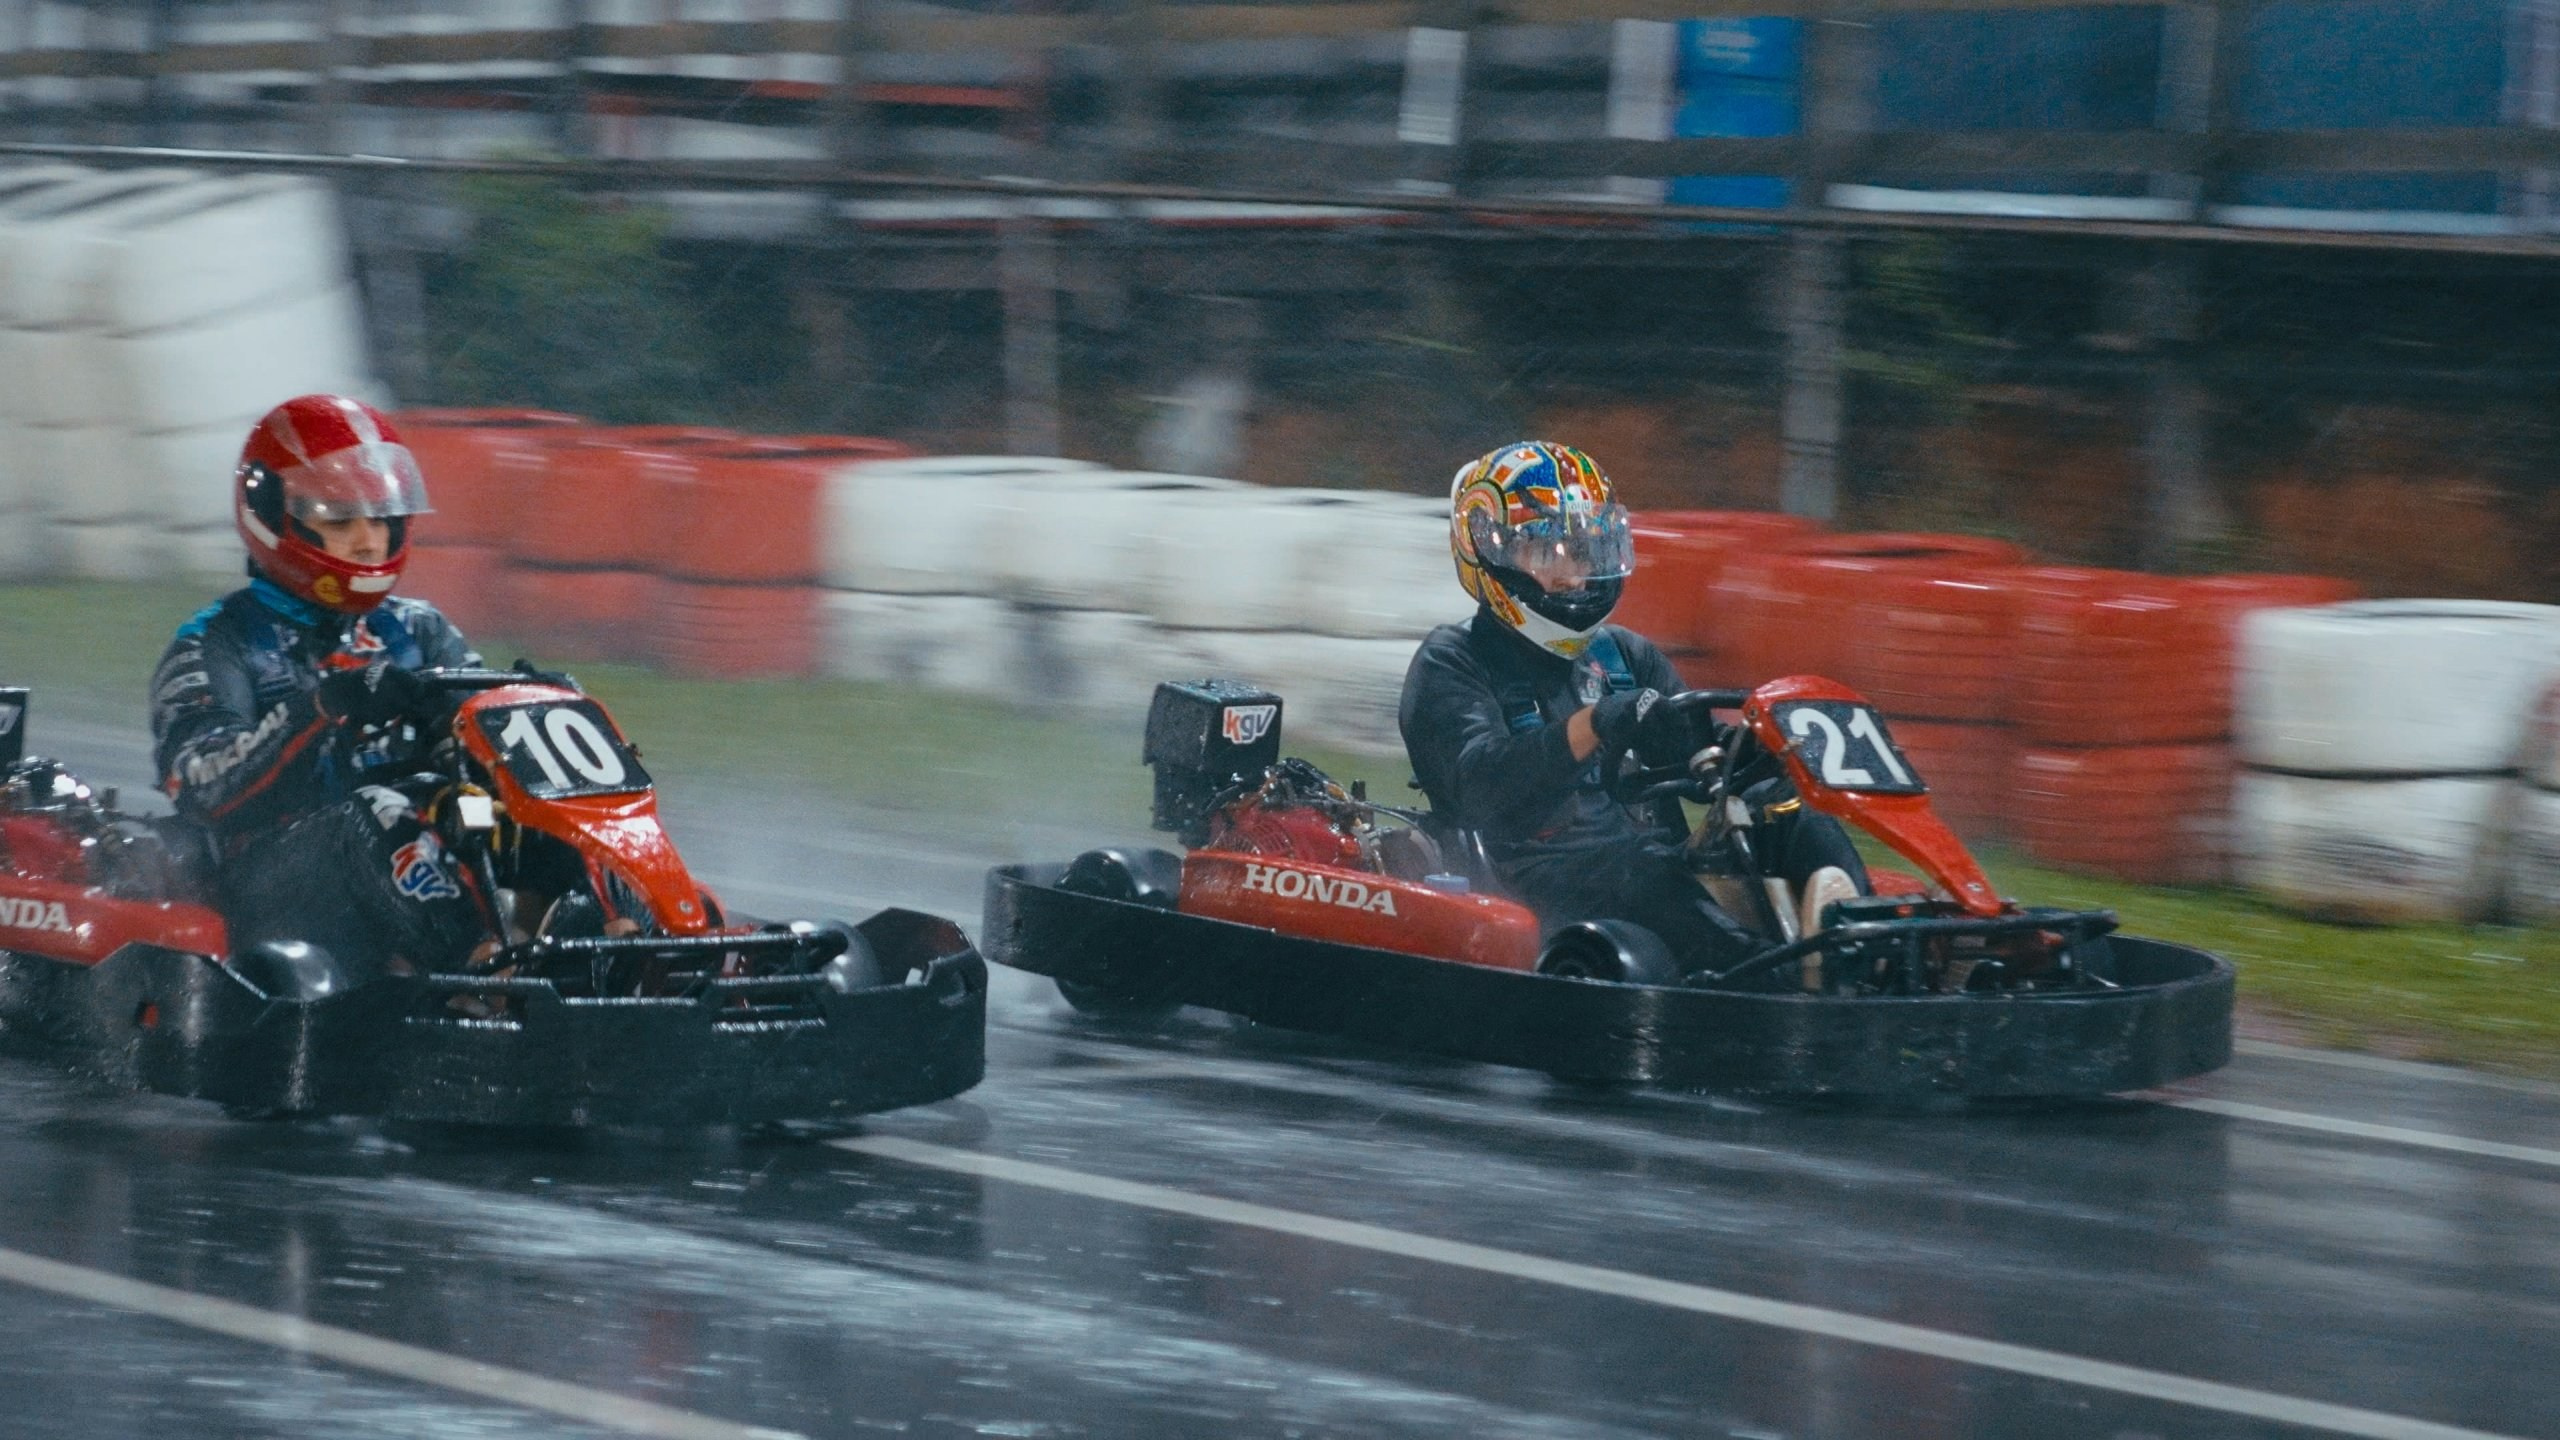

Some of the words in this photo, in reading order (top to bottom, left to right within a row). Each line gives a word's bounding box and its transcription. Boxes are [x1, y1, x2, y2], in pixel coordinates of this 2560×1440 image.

[501, 708, 626, 789] 10
[1225, 706, 1276, 742] kgv
[1789, 708, 1914, 785] 21
[1241, 863, 1397, 917] HONDA
